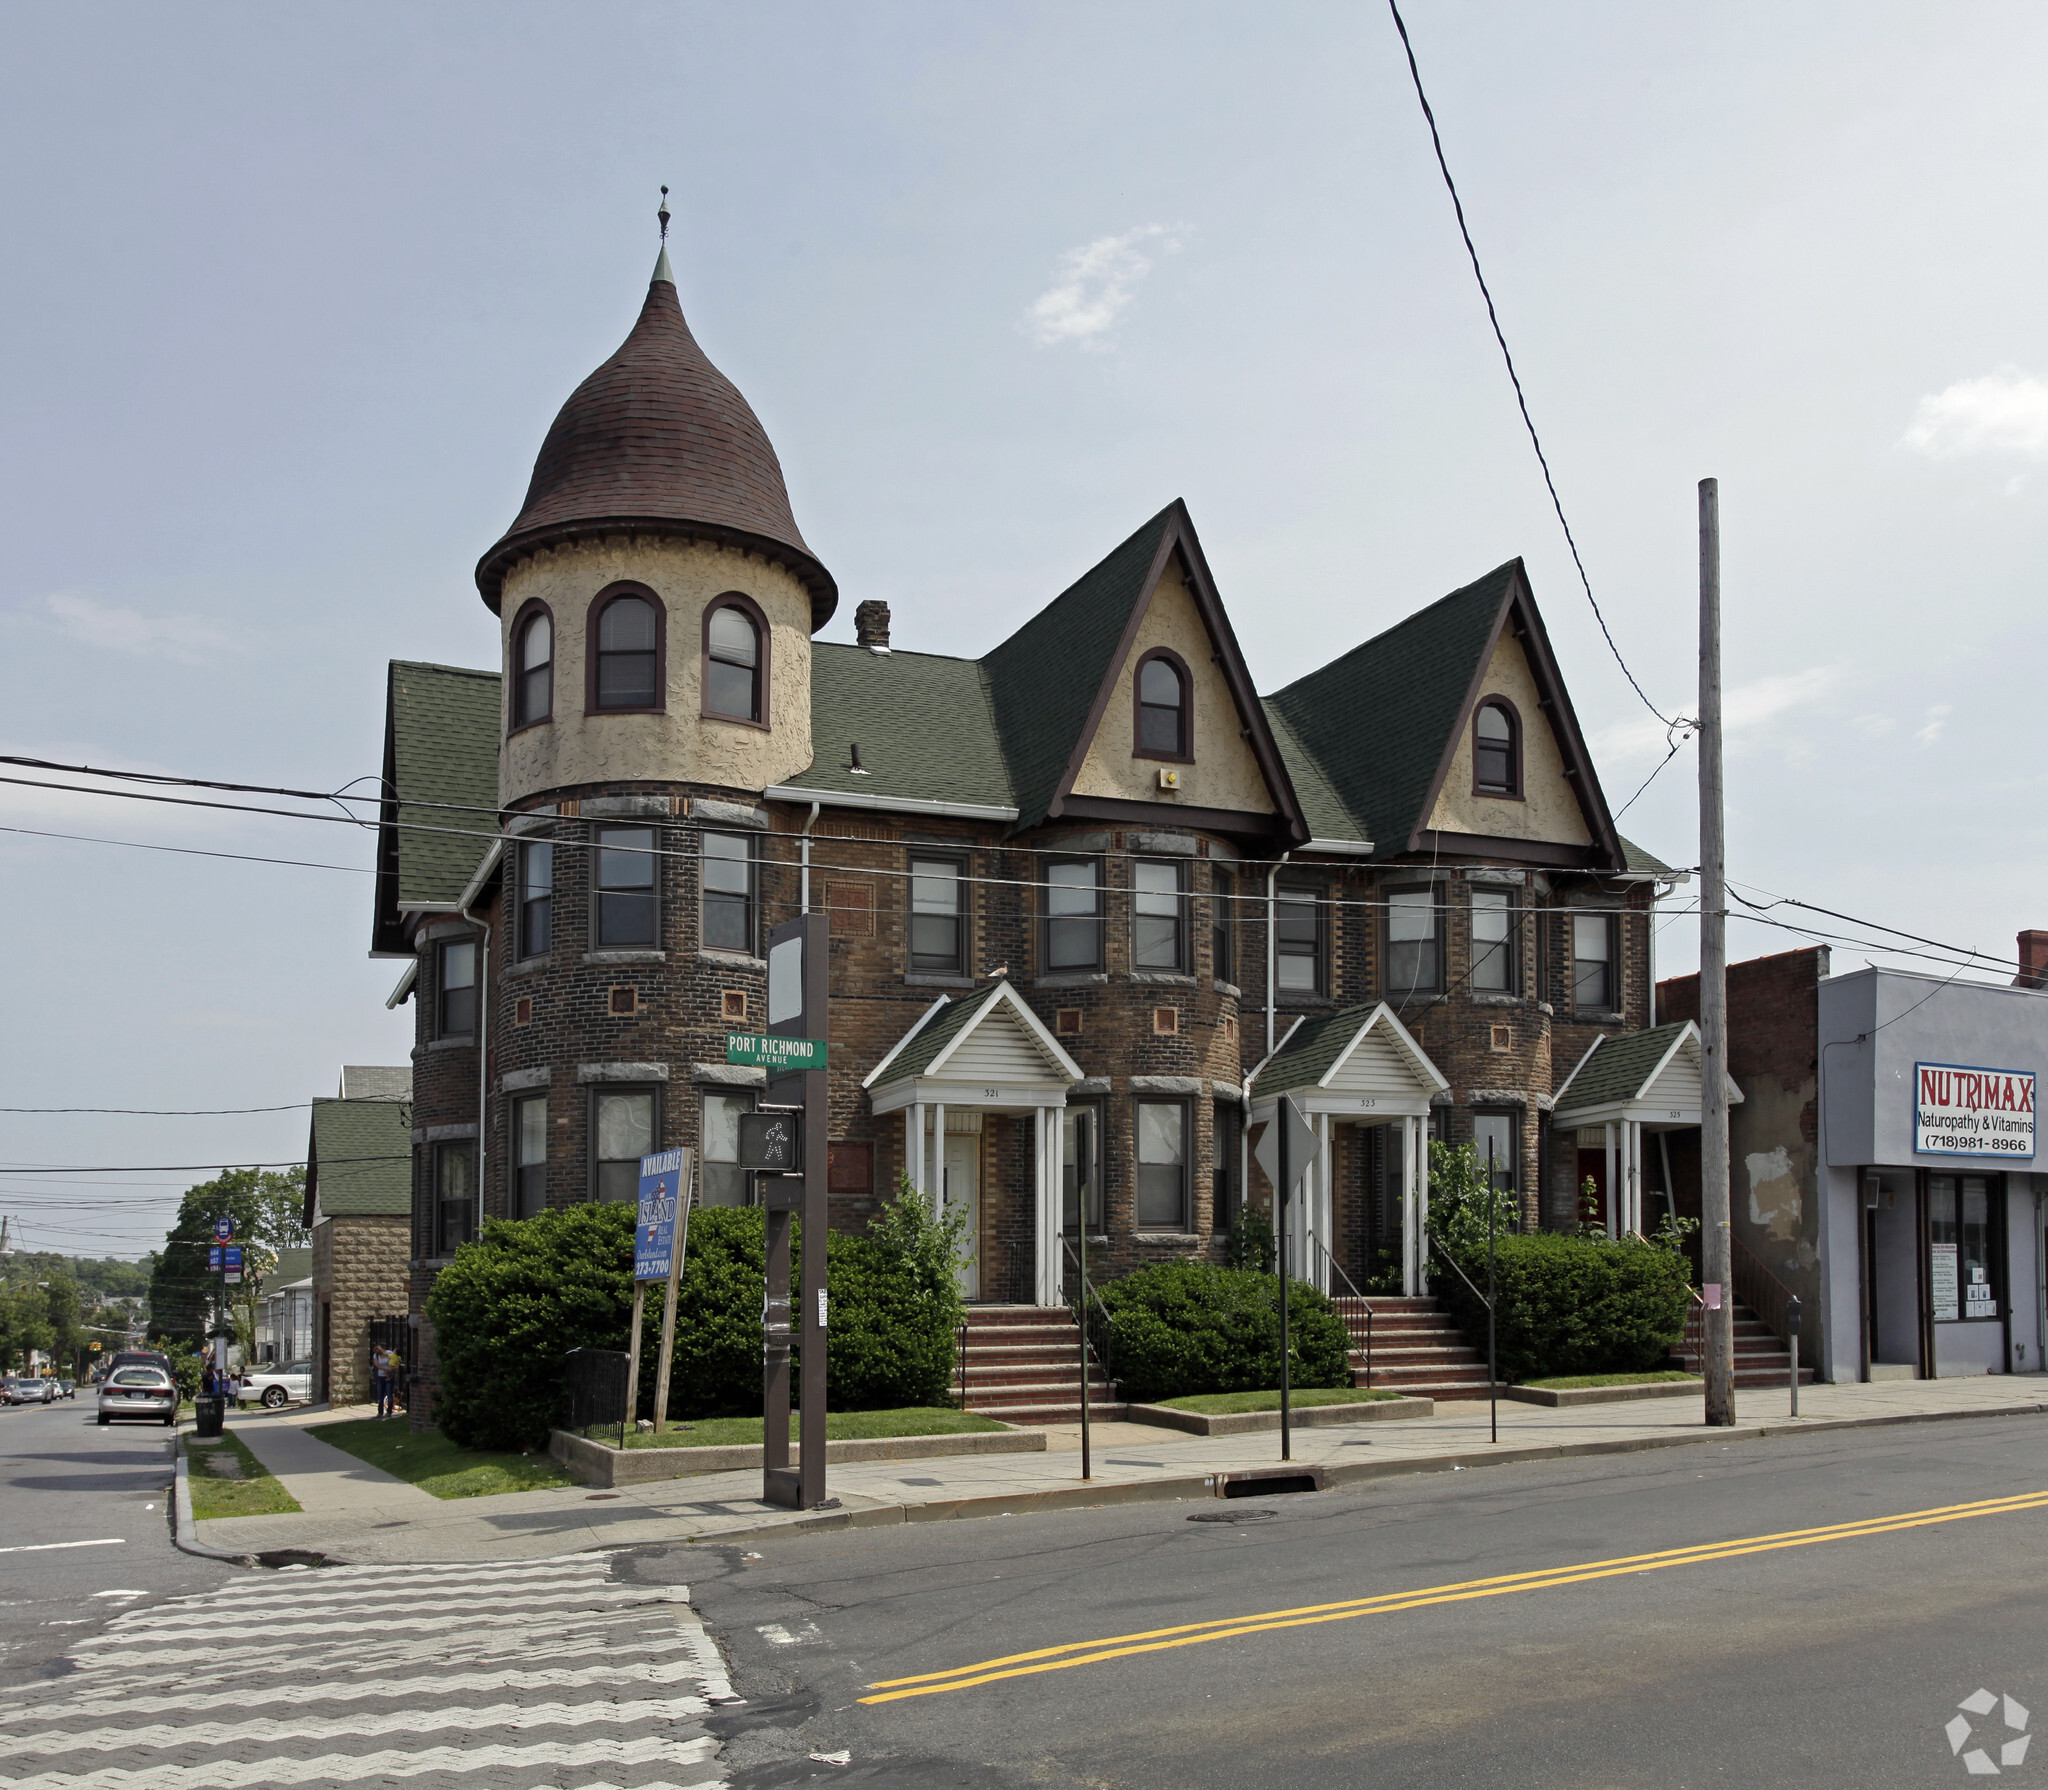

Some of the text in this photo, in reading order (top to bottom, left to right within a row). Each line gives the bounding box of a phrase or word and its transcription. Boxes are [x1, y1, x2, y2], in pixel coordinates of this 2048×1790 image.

[729, 1036, 814, 1057] PORT RICHMOND
[756, 1054, 787, 1064] AVENUE
[984, 1088, 998, 1098] 321
[1920, 1069, 2034, 1114] NUTRIMAX
[1918, 1111, 2033, 1134] Naturopathy & Vitamins
[641, 1151, 681, 1178] AVAILABLE
[638, 1197, 675, 1227] ISLAND
[658, 1225, 668, 1234] REAL
